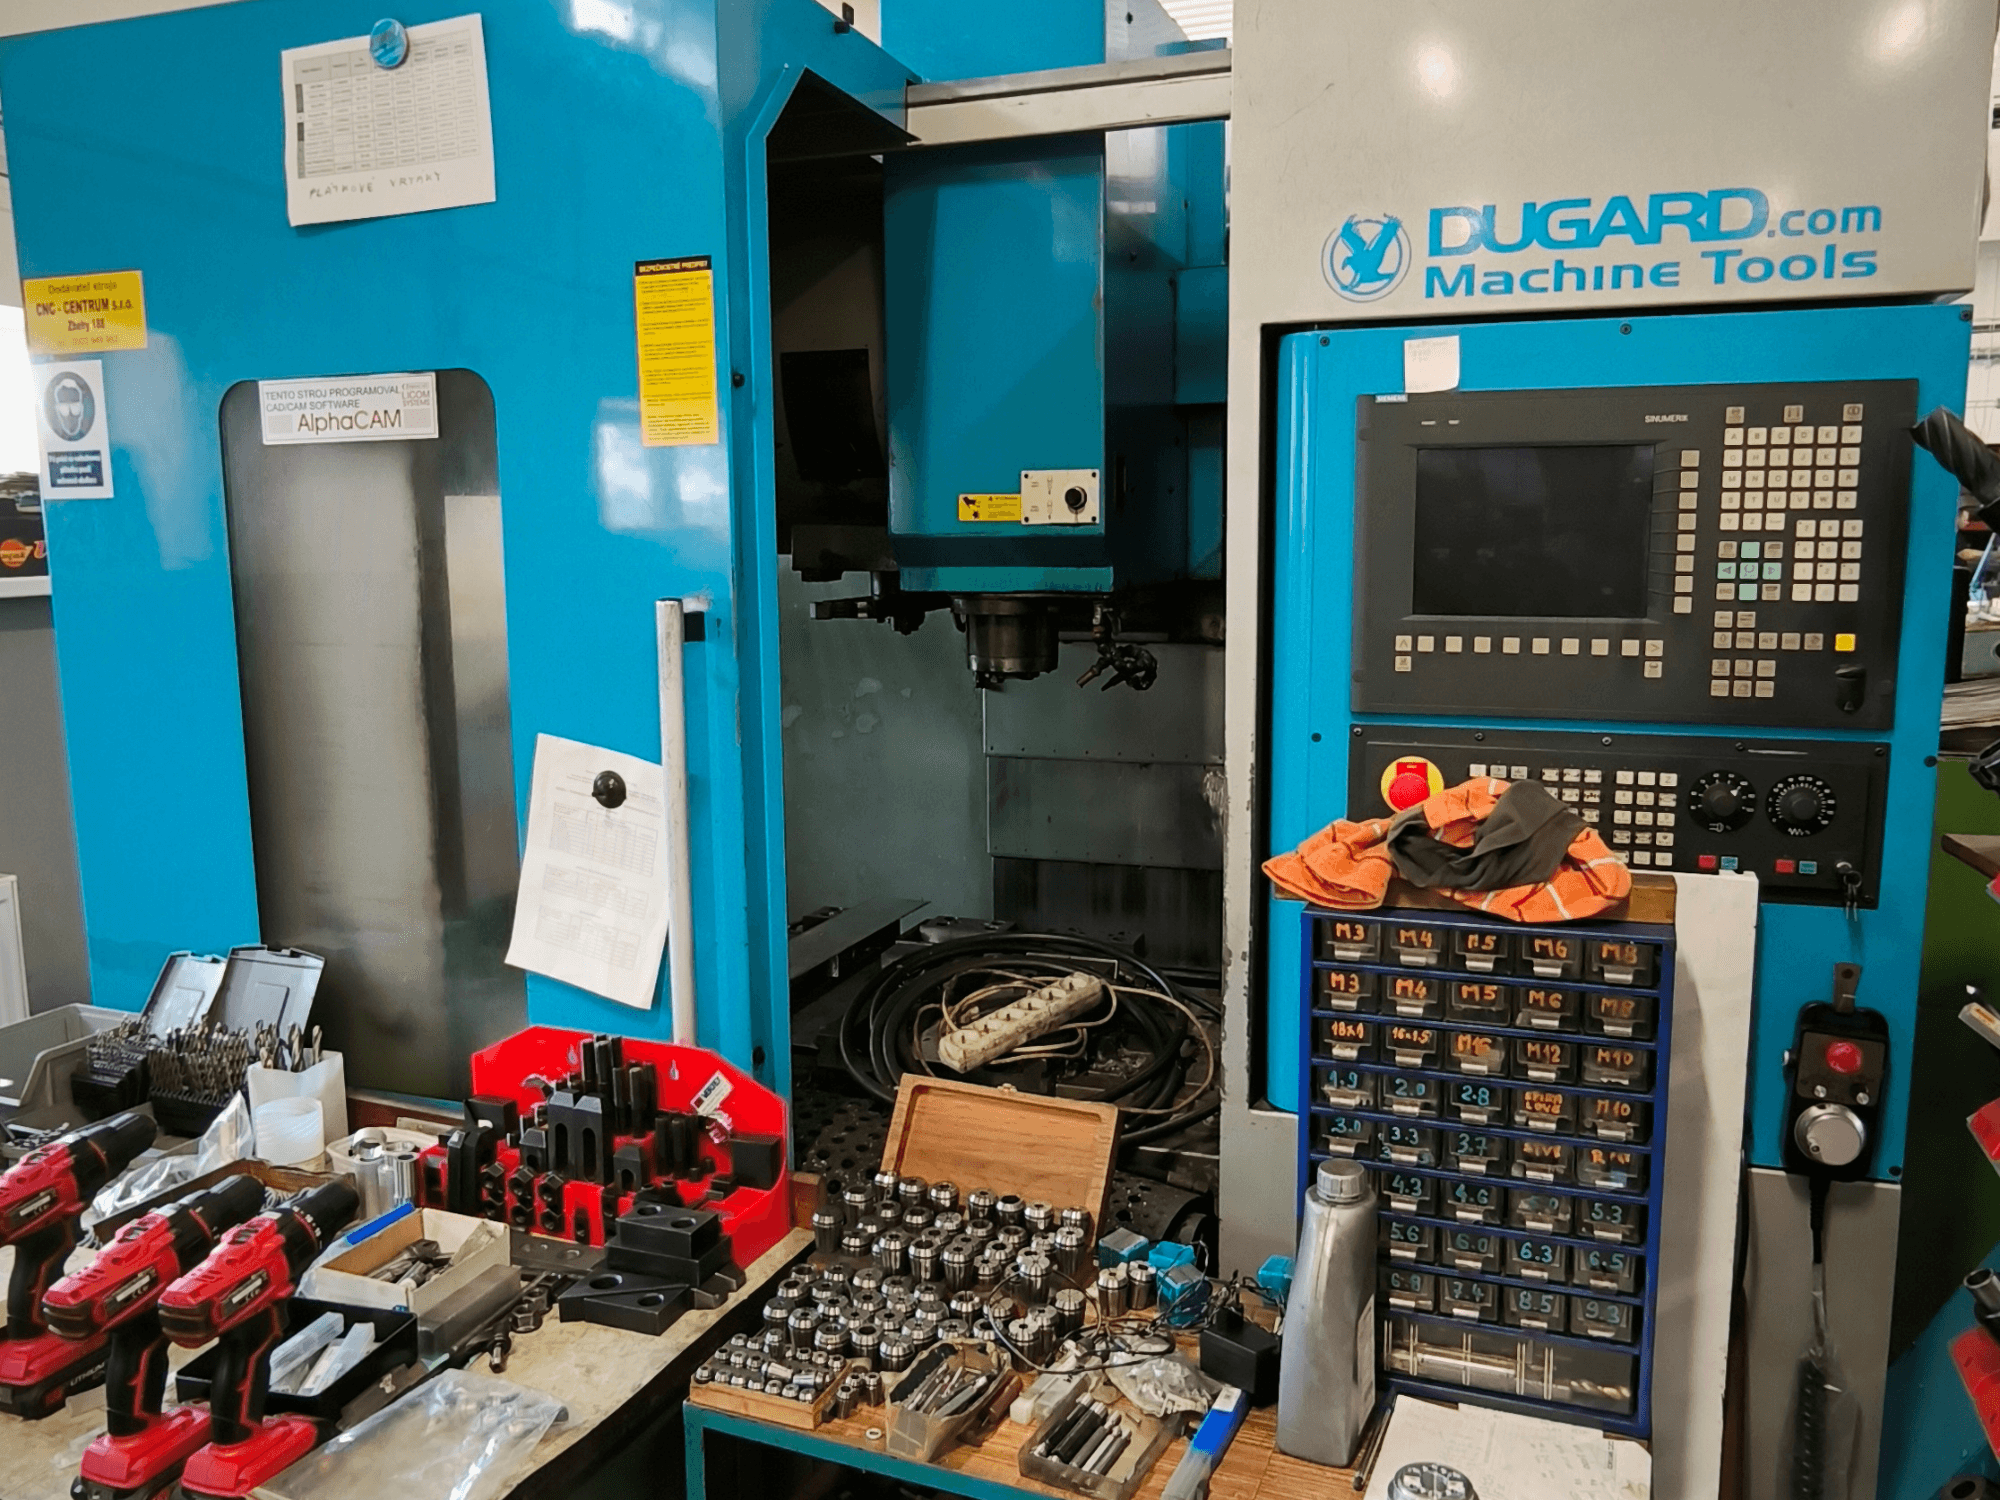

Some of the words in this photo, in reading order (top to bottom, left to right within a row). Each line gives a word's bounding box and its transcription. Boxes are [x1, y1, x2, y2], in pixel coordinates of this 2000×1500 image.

[1428, 187, 1882, 257] DUGARD.com
[1424, 259, 1680, 298] Machine
[1700, 244, 1878, 285] Tools
[36, 302, 57, 317] CNC
[63, 298, 109, 315] CENTRUM
[266, 390, 295, 401] TENTO
[297, 389, 327, 399] STROJ
[329, 385, 400, 397] PROGRAMOVAL
[266, 401, 307, 413] CAD/CAM
[309, 399, 360, 410] SOFTWARE
[297, 409, 402, 435] AlphaCAM
[1336, 923, 1364, 941] M3
[1400, 929, 1432, 948] M4
[1534, 938, 1567, 958] M6
[1602, 943, 1637, 964] M8
[1330, 971, 1360, 993] M3
[1396, 978, 1427, 999] M4
[1461, 985, 1497, 1001] M5
[1529, 990, 1562, 1008] M6
[1527, 1041, 1561, 1062] M12
[1597, 1049, 1633, 1066] M10
[1395, 1078, 1425, 1096] 2.0
[1462, 1085, 1490, 1106] 2.8
[1330, 1117, 1362, 1135] 3.0
[1391, 1126, 1419, 1145] 3.3
[1458, 1133, 1487, 1156] 3.7
[1392, 1175, 1422, 1197] 4.3
[1455, 1183, 1489, 1204] 4.6
[1591, 1202, 1622, 1224] 5.3
[1455, 1233, 1489, 1253] 6.0
[1520, 1241, 1552, 1263] 6.3
[1589, 1251, 1624, 1270] 6.5
